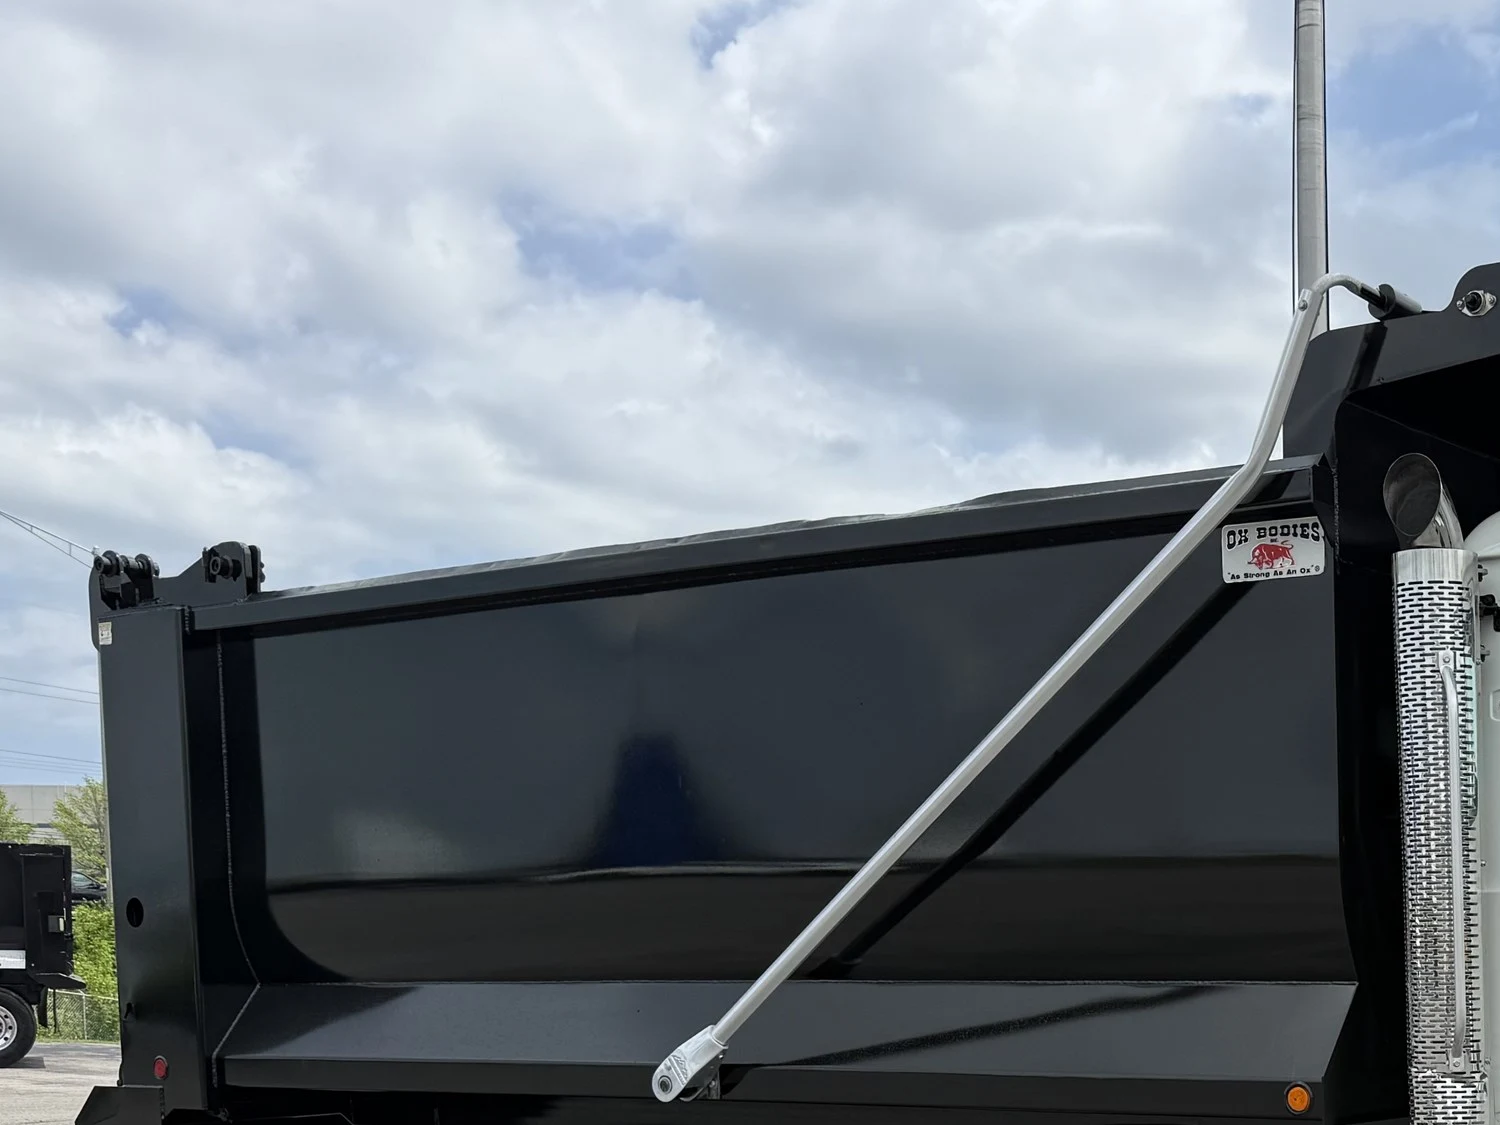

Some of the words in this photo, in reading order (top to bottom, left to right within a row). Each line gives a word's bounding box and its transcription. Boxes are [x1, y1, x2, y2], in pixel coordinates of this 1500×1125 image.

[1226, 529, 1249, 550] OX
[1256, 521, 1320, 542] BODIES
[1243, 571, 1271, 579] Strong
